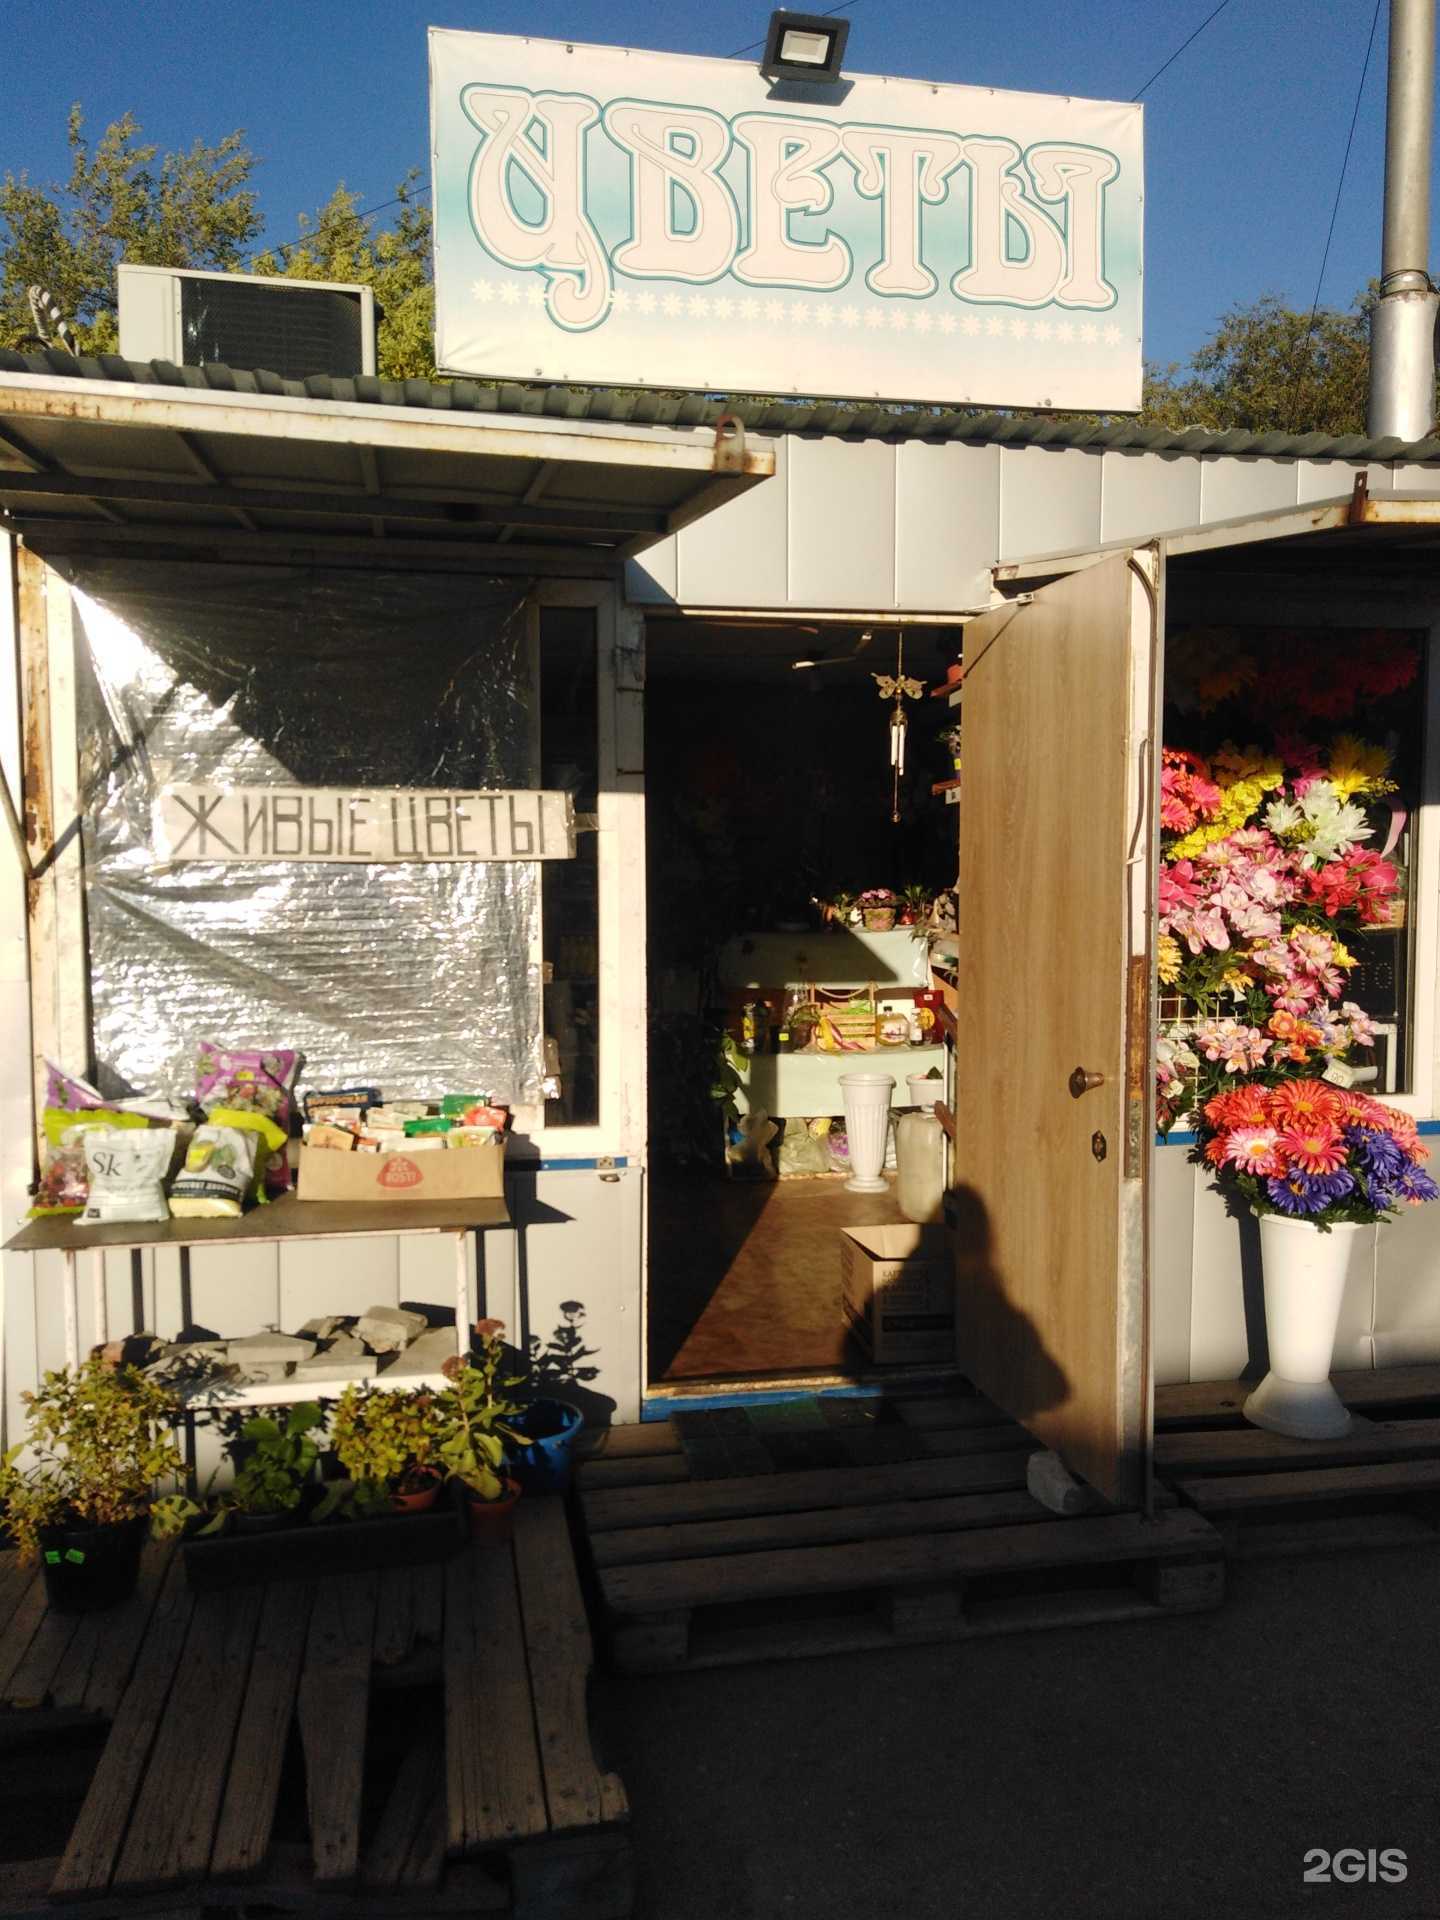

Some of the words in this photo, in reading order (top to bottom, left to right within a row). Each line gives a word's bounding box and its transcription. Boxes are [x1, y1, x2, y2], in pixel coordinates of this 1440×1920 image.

[461, 83, 1121, 333] ЦВЕТЫ
[172, 794, 372, 856] ЖИВЫЕ
[391, 794, 544, 859] ЦВЕТЫ
